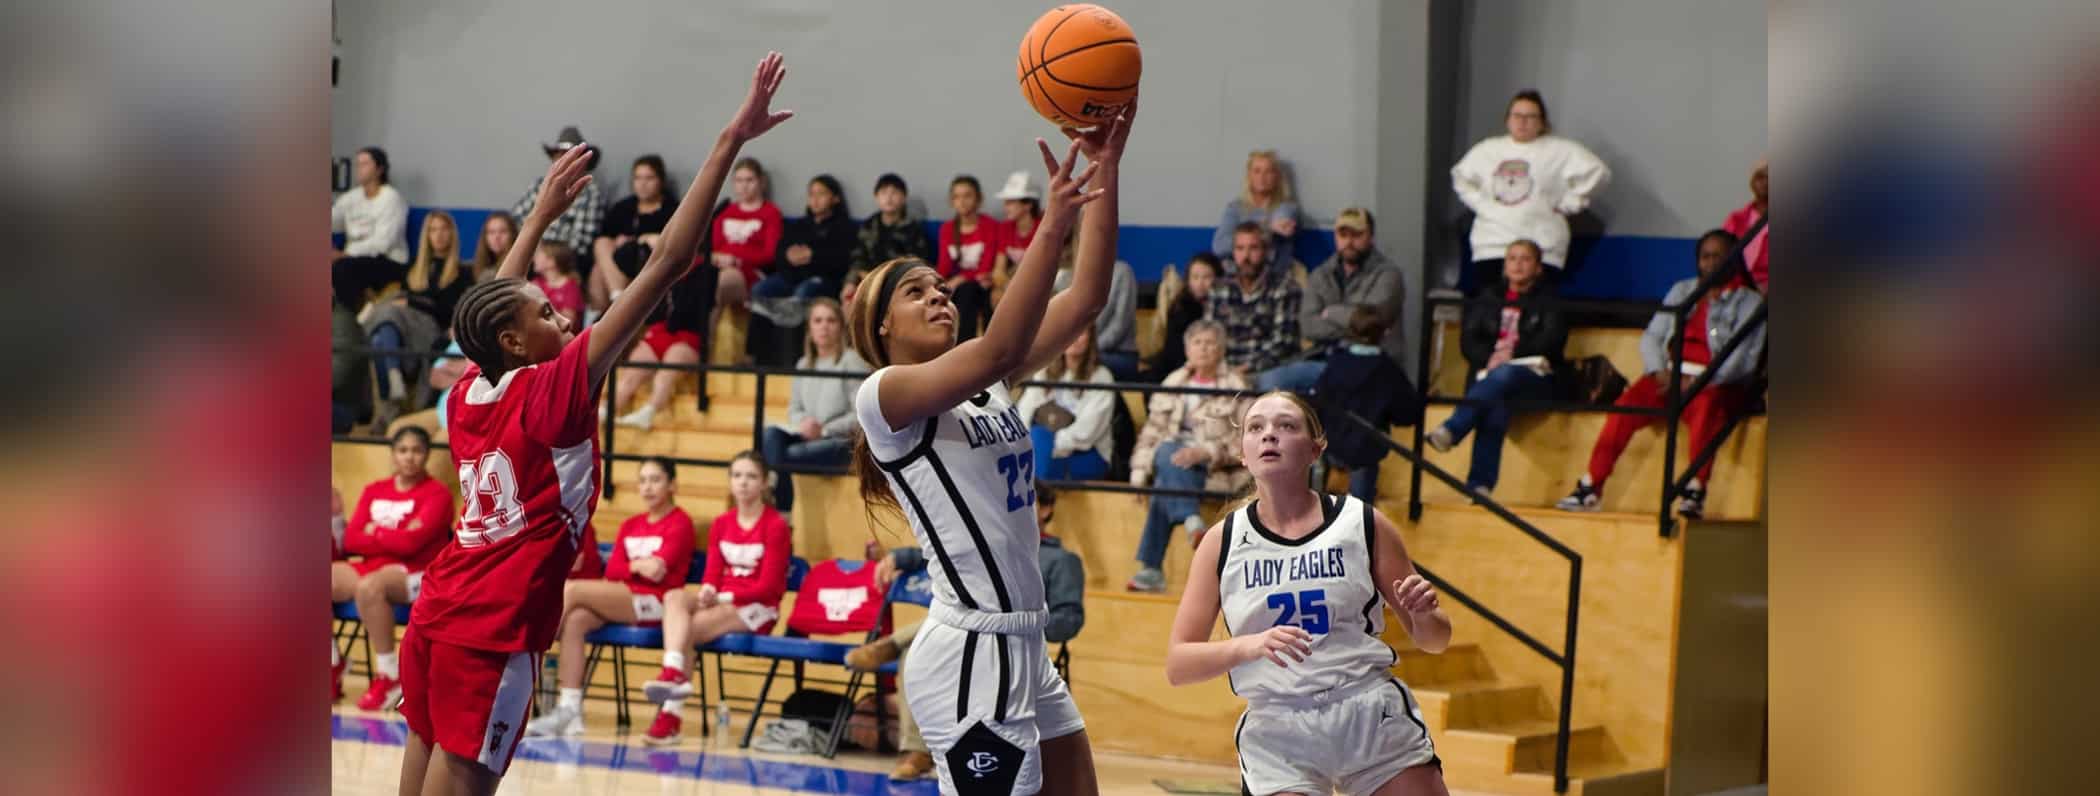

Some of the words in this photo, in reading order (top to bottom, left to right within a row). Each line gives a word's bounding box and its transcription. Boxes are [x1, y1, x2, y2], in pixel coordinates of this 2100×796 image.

[1244, 559, 1284, 590] LADY
[1289, 547, 1345, 581] EAGLES
[1267, 588, 1329, 635] 25
